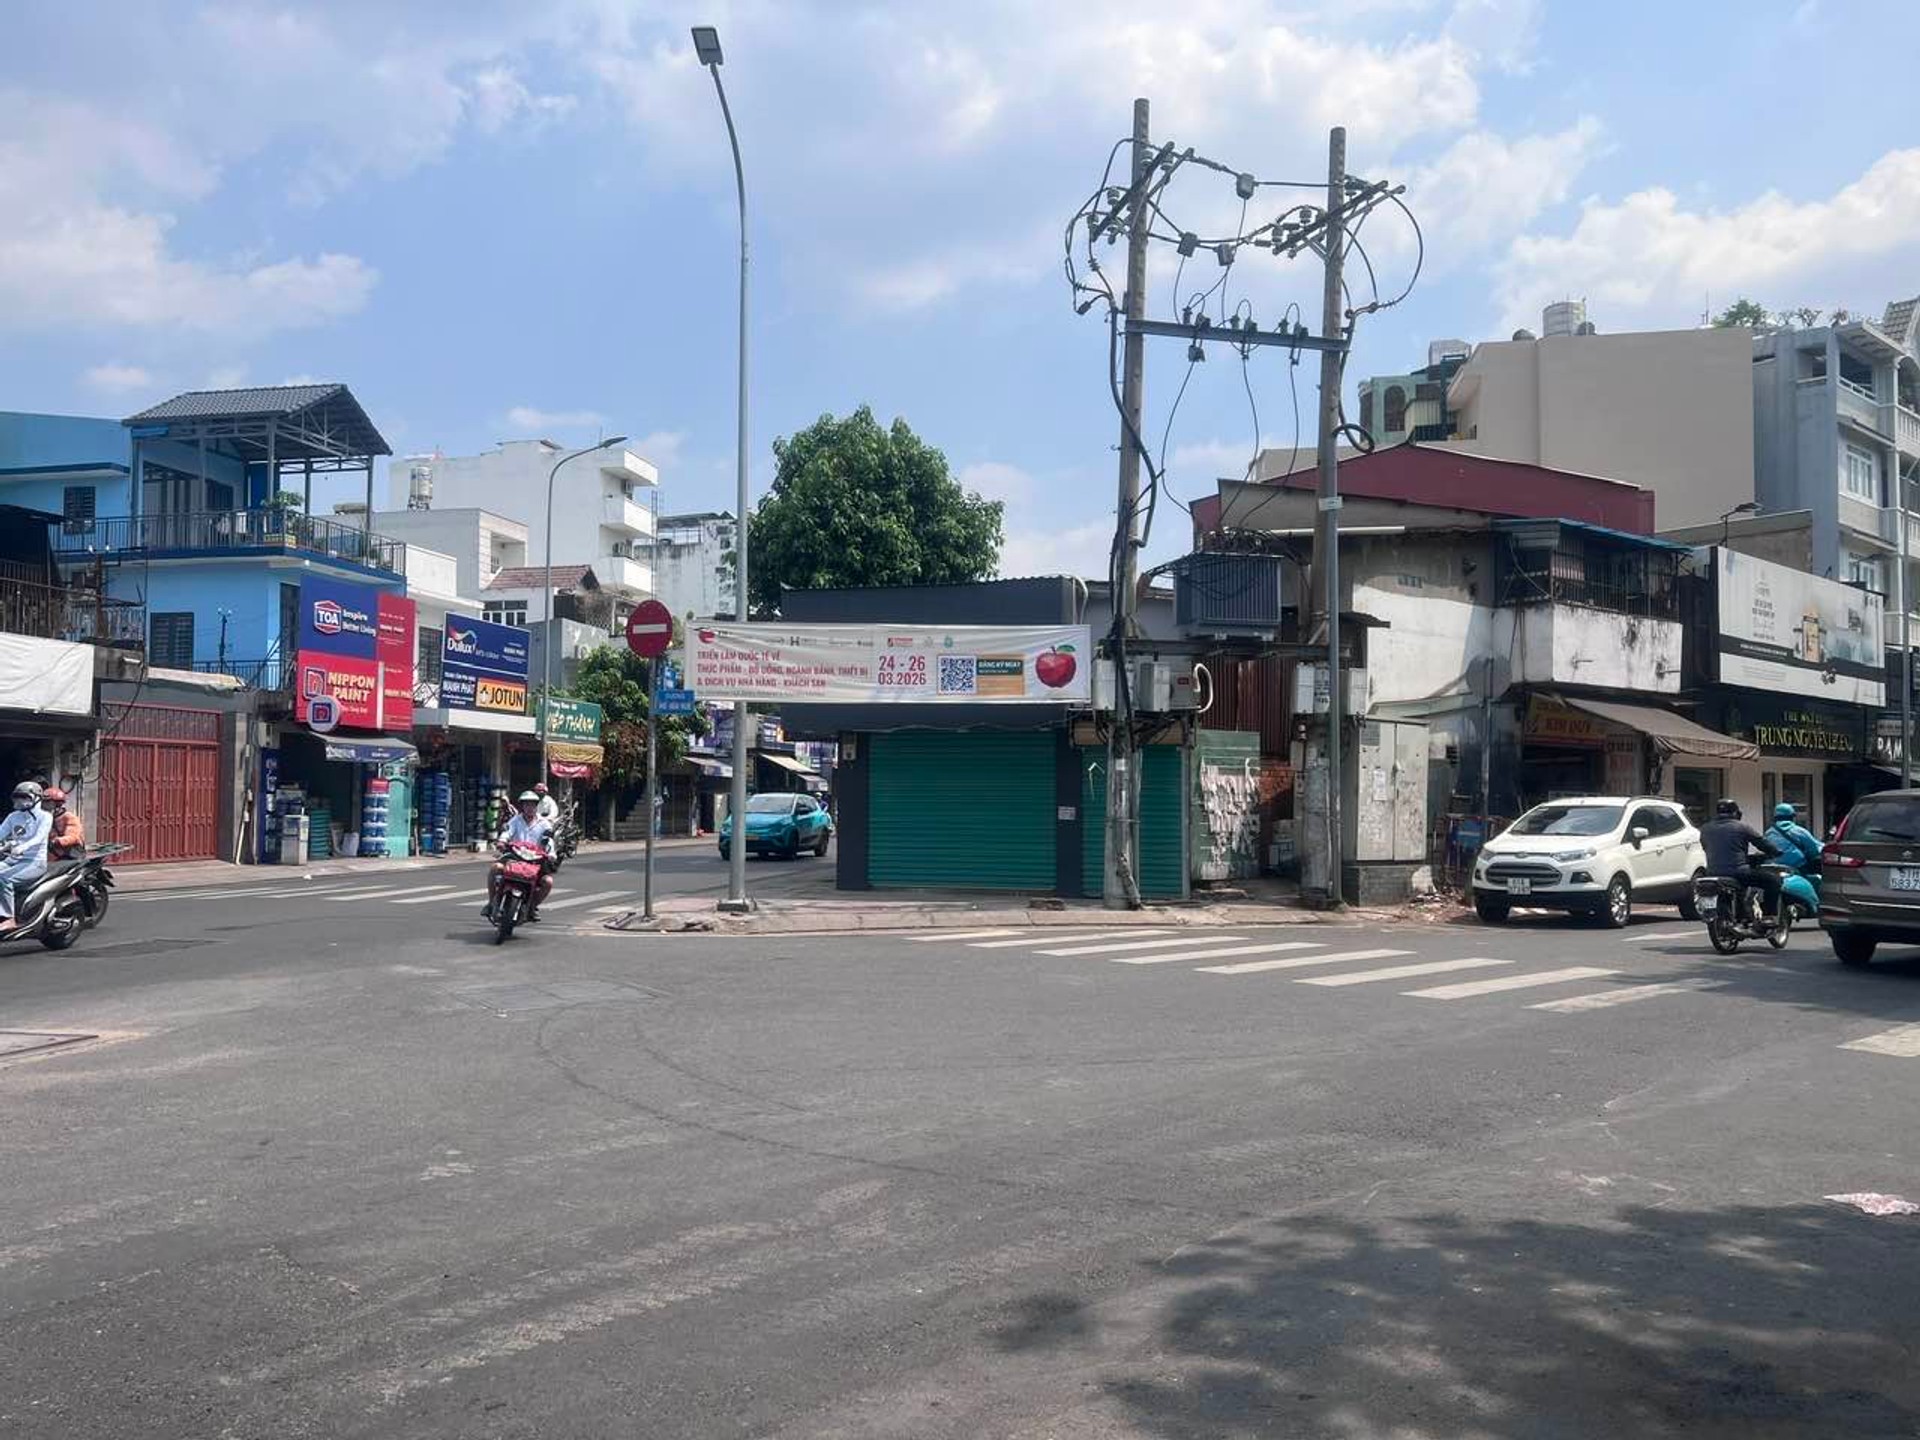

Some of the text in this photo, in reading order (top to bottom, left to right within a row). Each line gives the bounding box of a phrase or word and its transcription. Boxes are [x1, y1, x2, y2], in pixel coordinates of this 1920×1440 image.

[318, 610, 339, 625] TOA
[448, 637, 473, 654] Dulux
[697, 650, 719, 660] TRIỂN
[720, 650, 737, 660] LÃM
[761, 650, 770, 660] TẾ
[771, 650, 780, 661] VỀ
[878, 655, 895, 671] 24
[909, 655, 926, 671] 26
[697, 664, 718, 675] THỰC
[719, 664, 743, 674] PHẨM
[327, 671, 376, 689] NIPPON
[704, 677, 724, 688] DỊCH
[725, 677, 737, 688] VỤ
[755, 677, 777, 687] HÀNG
[783, 678, 810, 688] KHÁCH
[878, 672, 927, 686] 03.2026
[333, 686, 372, 702] PAINT
[490, 687, 523, 707] JOTUN
